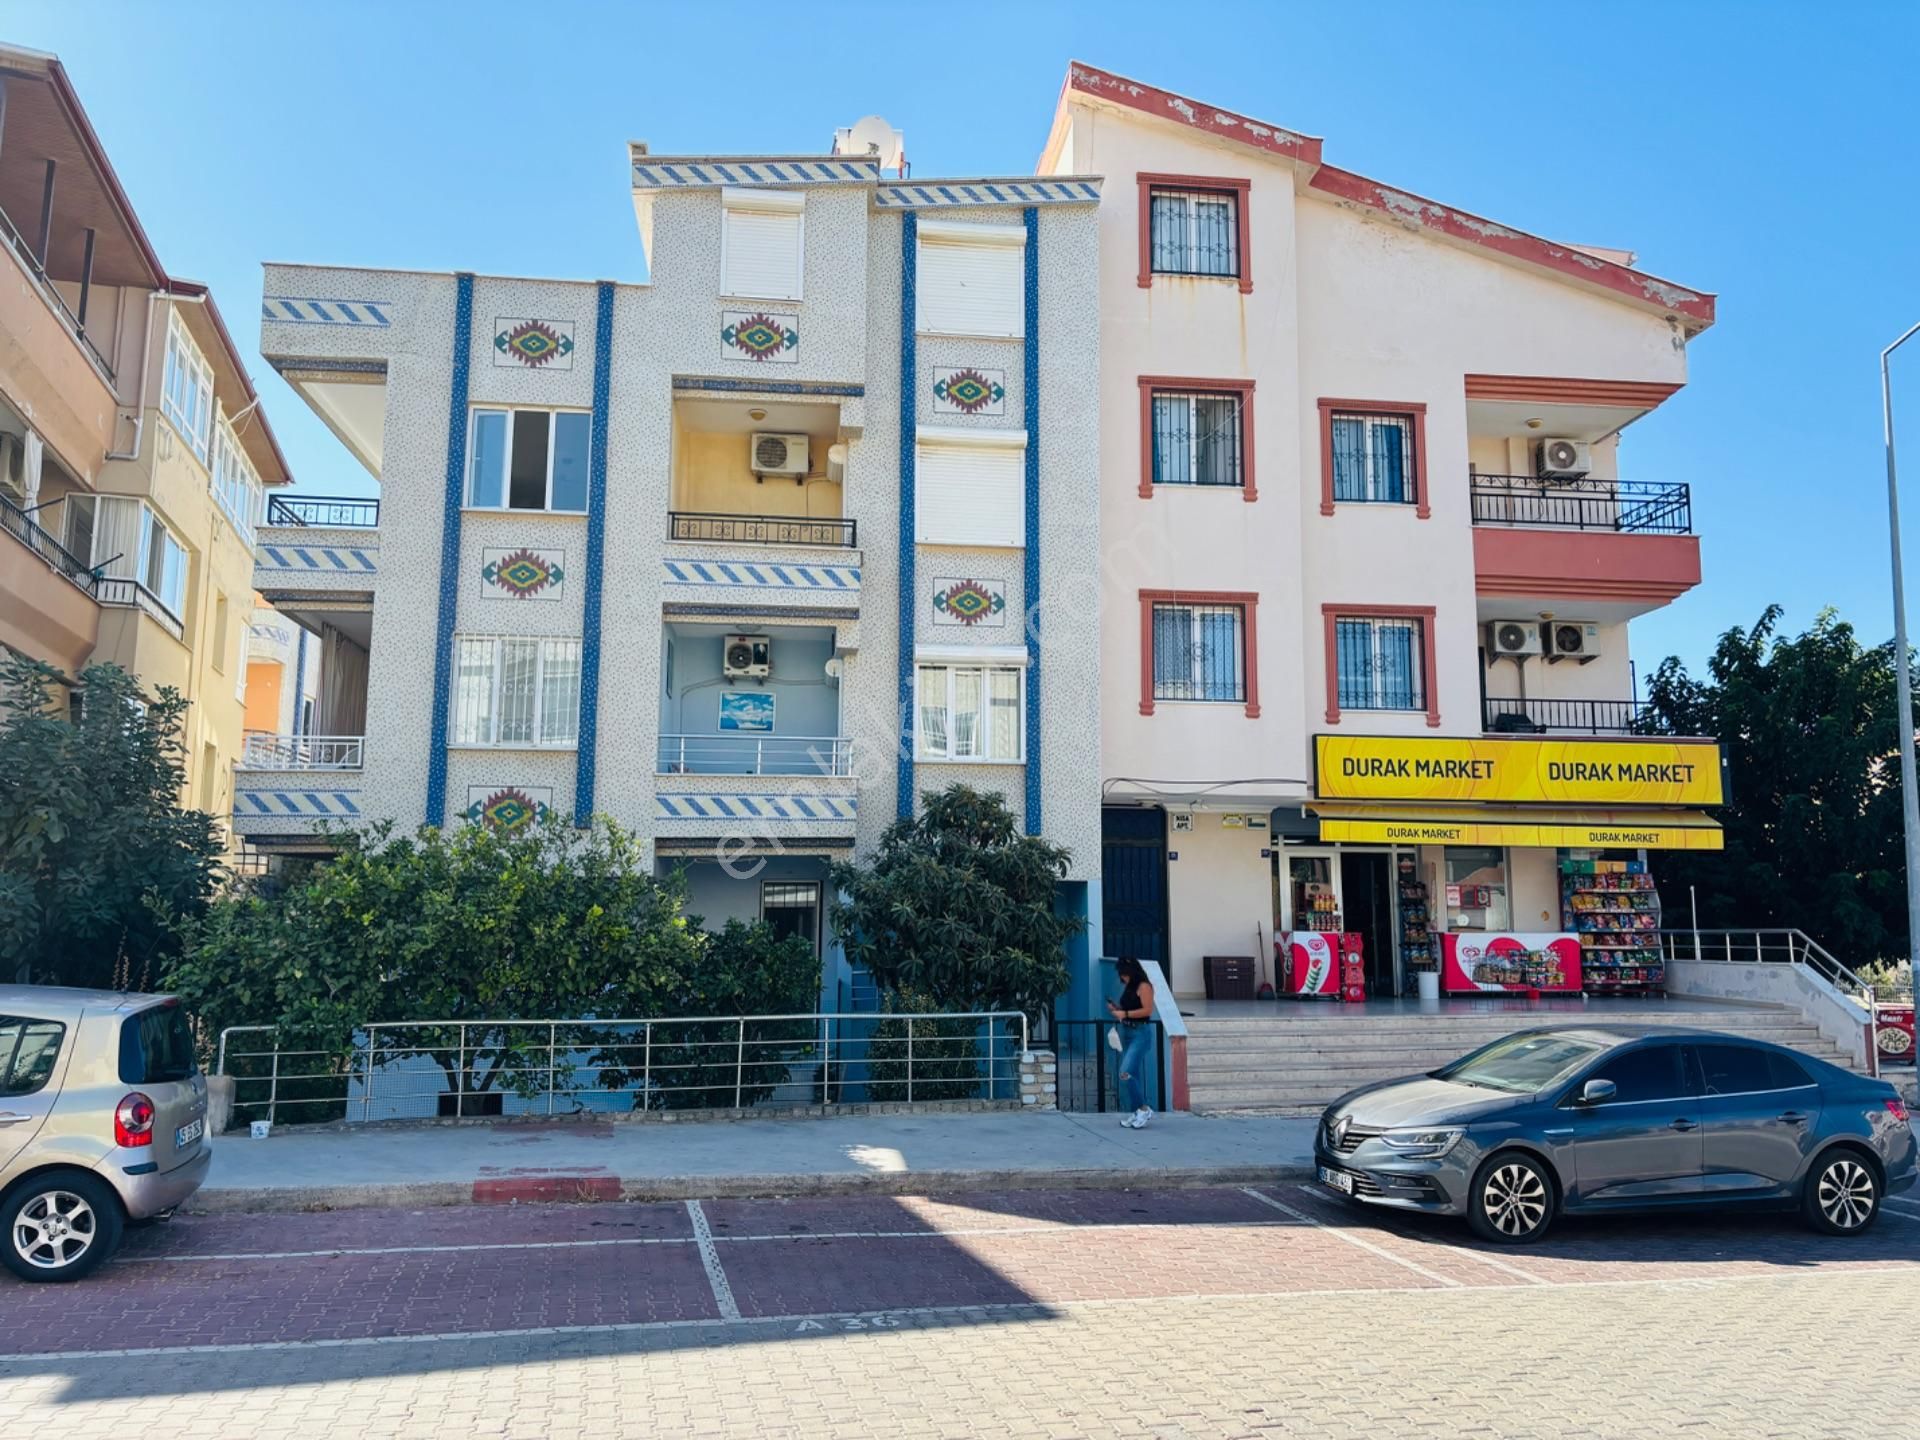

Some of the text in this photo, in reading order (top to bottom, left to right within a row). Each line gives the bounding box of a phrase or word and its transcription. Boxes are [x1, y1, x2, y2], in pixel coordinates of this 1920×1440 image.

[1343, 758, 1495, 779] DURAK MARKET
[1548, 762, 1695, 783] DURAK MARKET
[1386, 827, 1462, 840] DURAK MARKET
[1588, 831, 1661, 844] DURAK MARKET
[794, 1316, 901, 1332] A 36
